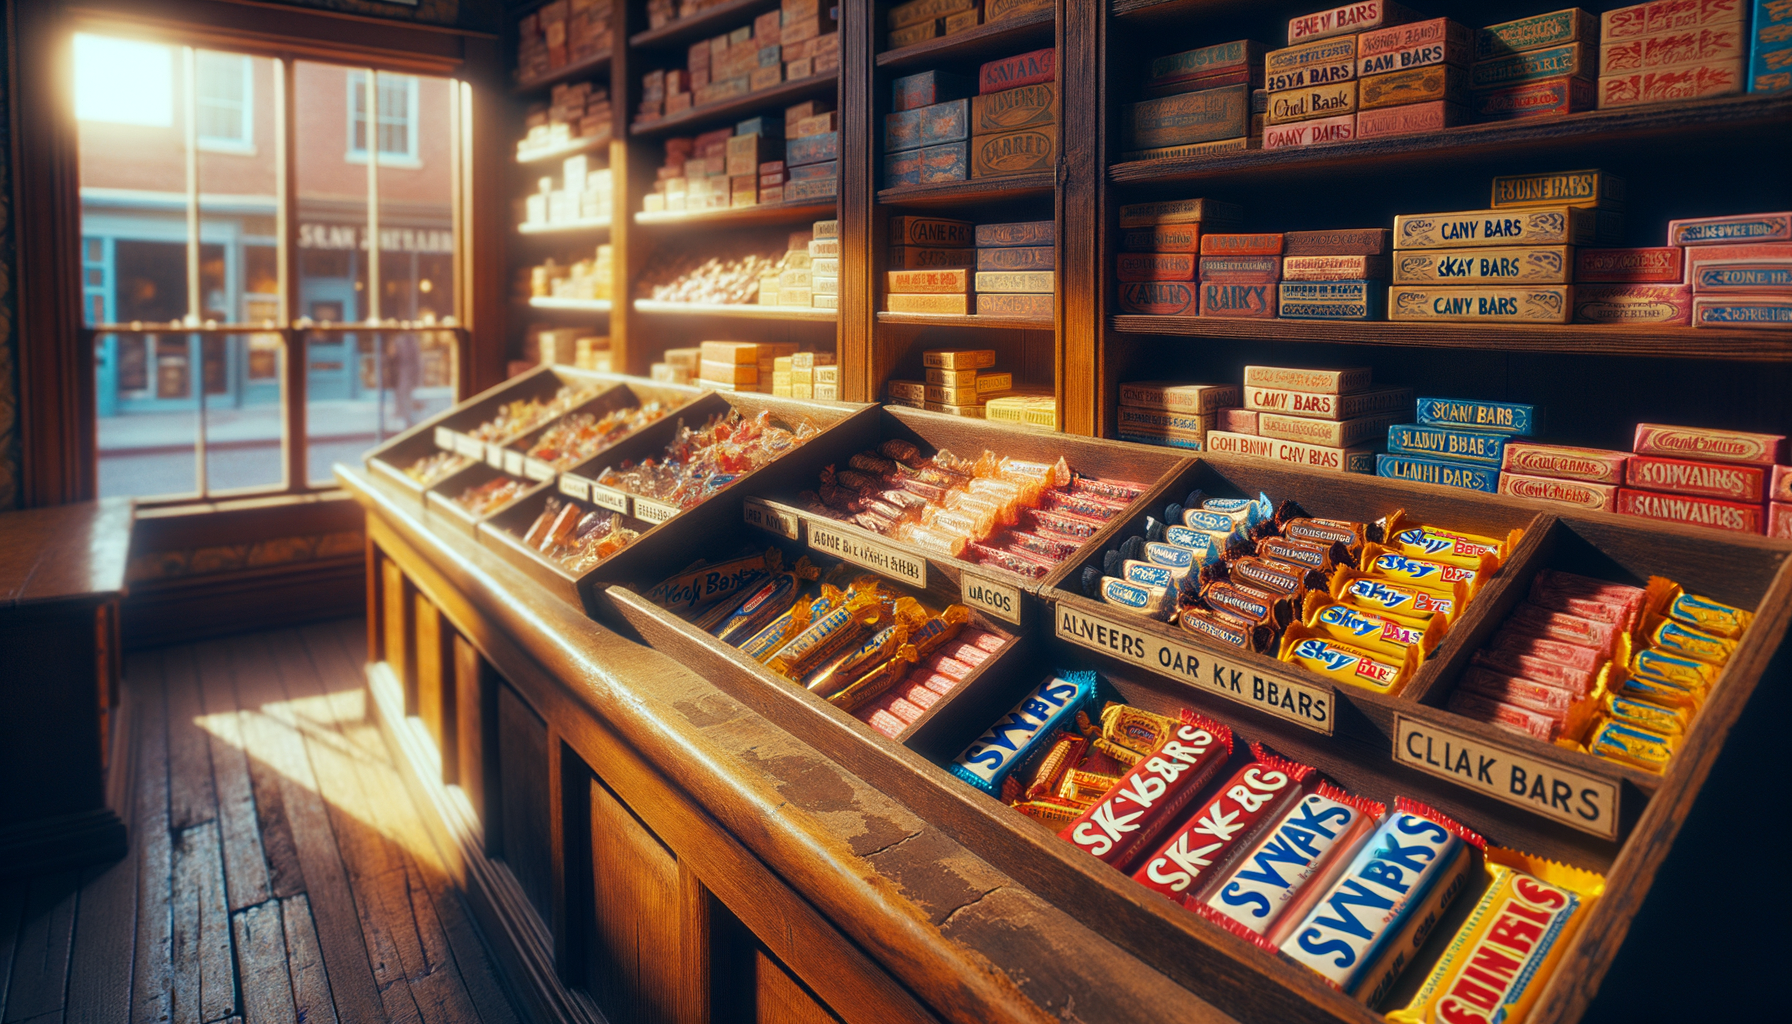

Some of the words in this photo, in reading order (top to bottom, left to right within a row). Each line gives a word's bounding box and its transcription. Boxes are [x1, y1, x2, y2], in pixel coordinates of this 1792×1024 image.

[1336, 3, 1378, 28] BARS
[1400, 45, 1443, 67] BARS
[1441, 220, 1479, 241] CANY
[1484, 218, 1522, 238] BARS
[1480, 256, 1520, 278] BARS
[1433, 297, 1475, 316] CANY
[1478, 297, 1518, 316] BARS
[1293, 394, 1331, 413] BARS
[1477, 405, 1514, 426] BARS
[1158, 646, 1200, 679] OAR
[1213, 662, 1243, 695] KK
[1253, 675, 1327, 723] BBARS
[1509, 765, 1600, 822] BARS
